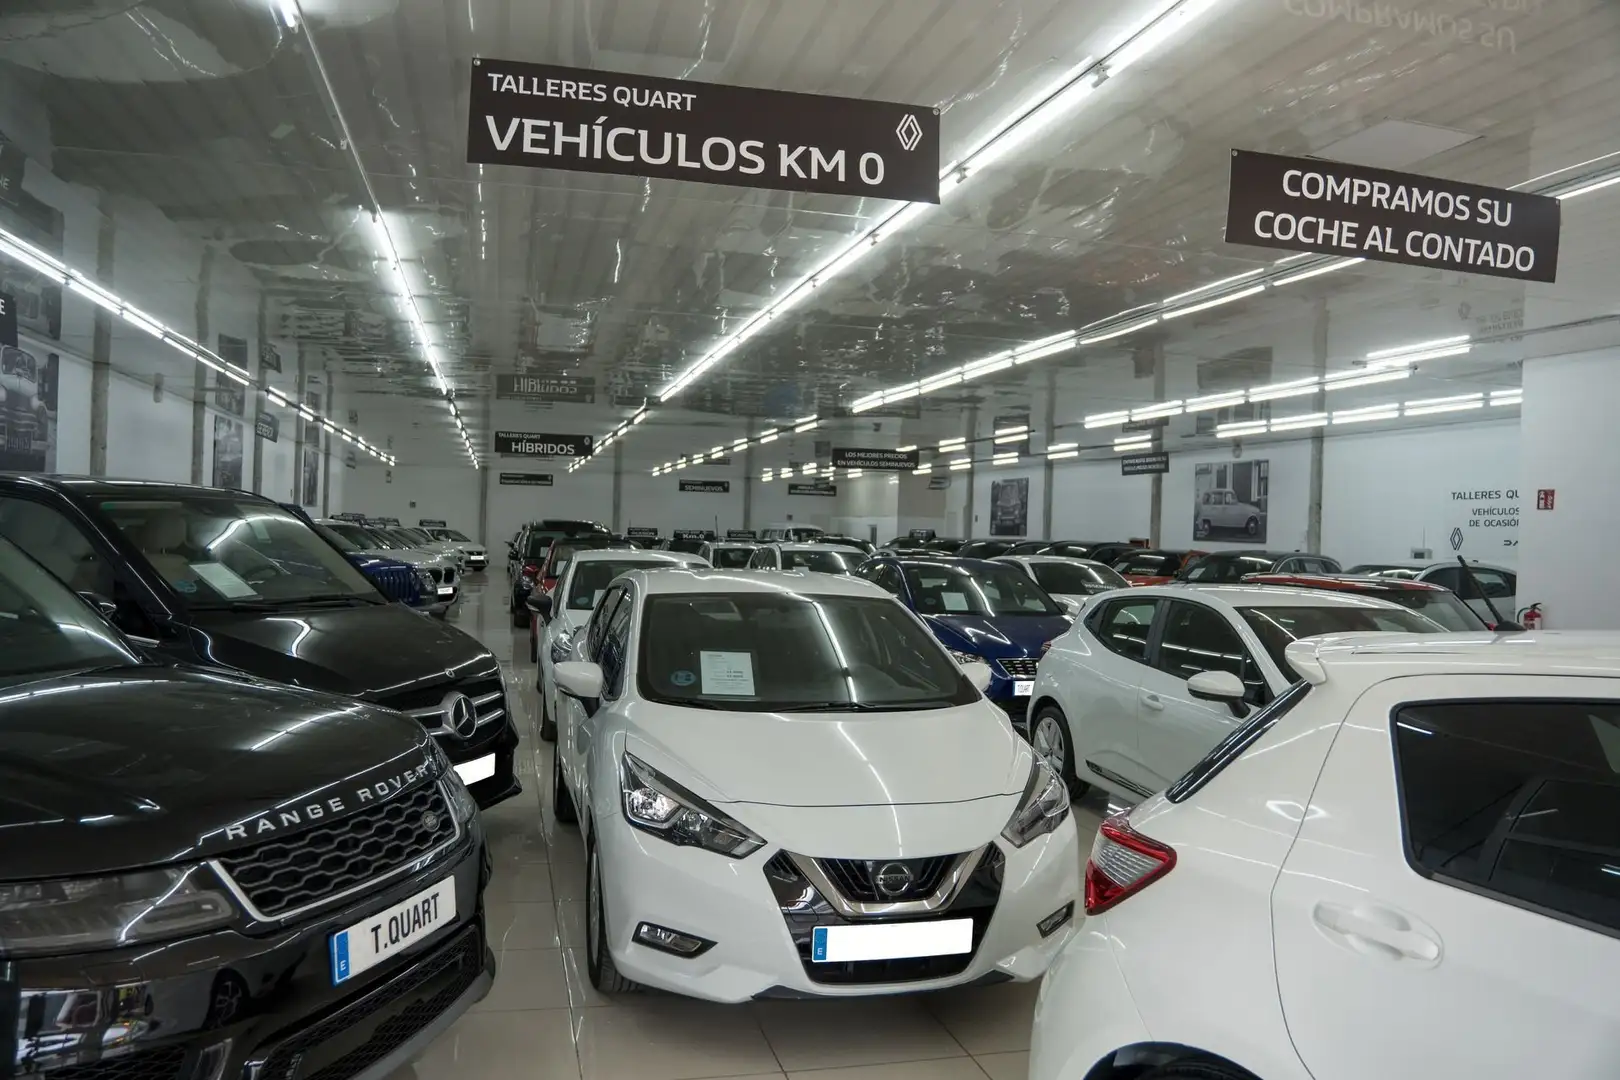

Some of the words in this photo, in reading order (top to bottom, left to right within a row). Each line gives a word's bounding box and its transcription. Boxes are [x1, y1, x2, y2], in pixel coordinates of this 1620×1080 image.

[487, 72, 607, 102] TALLERES
[613, 86, 697, 112] QUART
[485, 115, 765, 175] VEHÍCULOS
[778, 143, 846, 182] KM
[859, 152, 885, 185] 0
[1282, 169, 1471, 221] COMPRAMOS
[1476, 198, 1512, 227] SU
[1254, 210, 1359, 249] COCHE
[1363, 225, 1399, 255] AL
[1405, 230, 1535, 272] CONTADO
[511, 440, 575, 455] HÍBRIDOS
[1451, 490, 1501, 500] TALLERES
[1469, 519, 1480, 527] DE
[1472, 506, 1519, 516] VEHÍCULOS
[224, 797, 345, 841] RANGE
[357, 765, 428, 802] ROVER
[370, 892, 440, 954] T.QUART
[340, 959, 347, 971] E
[817, 947, 823, 956] E
